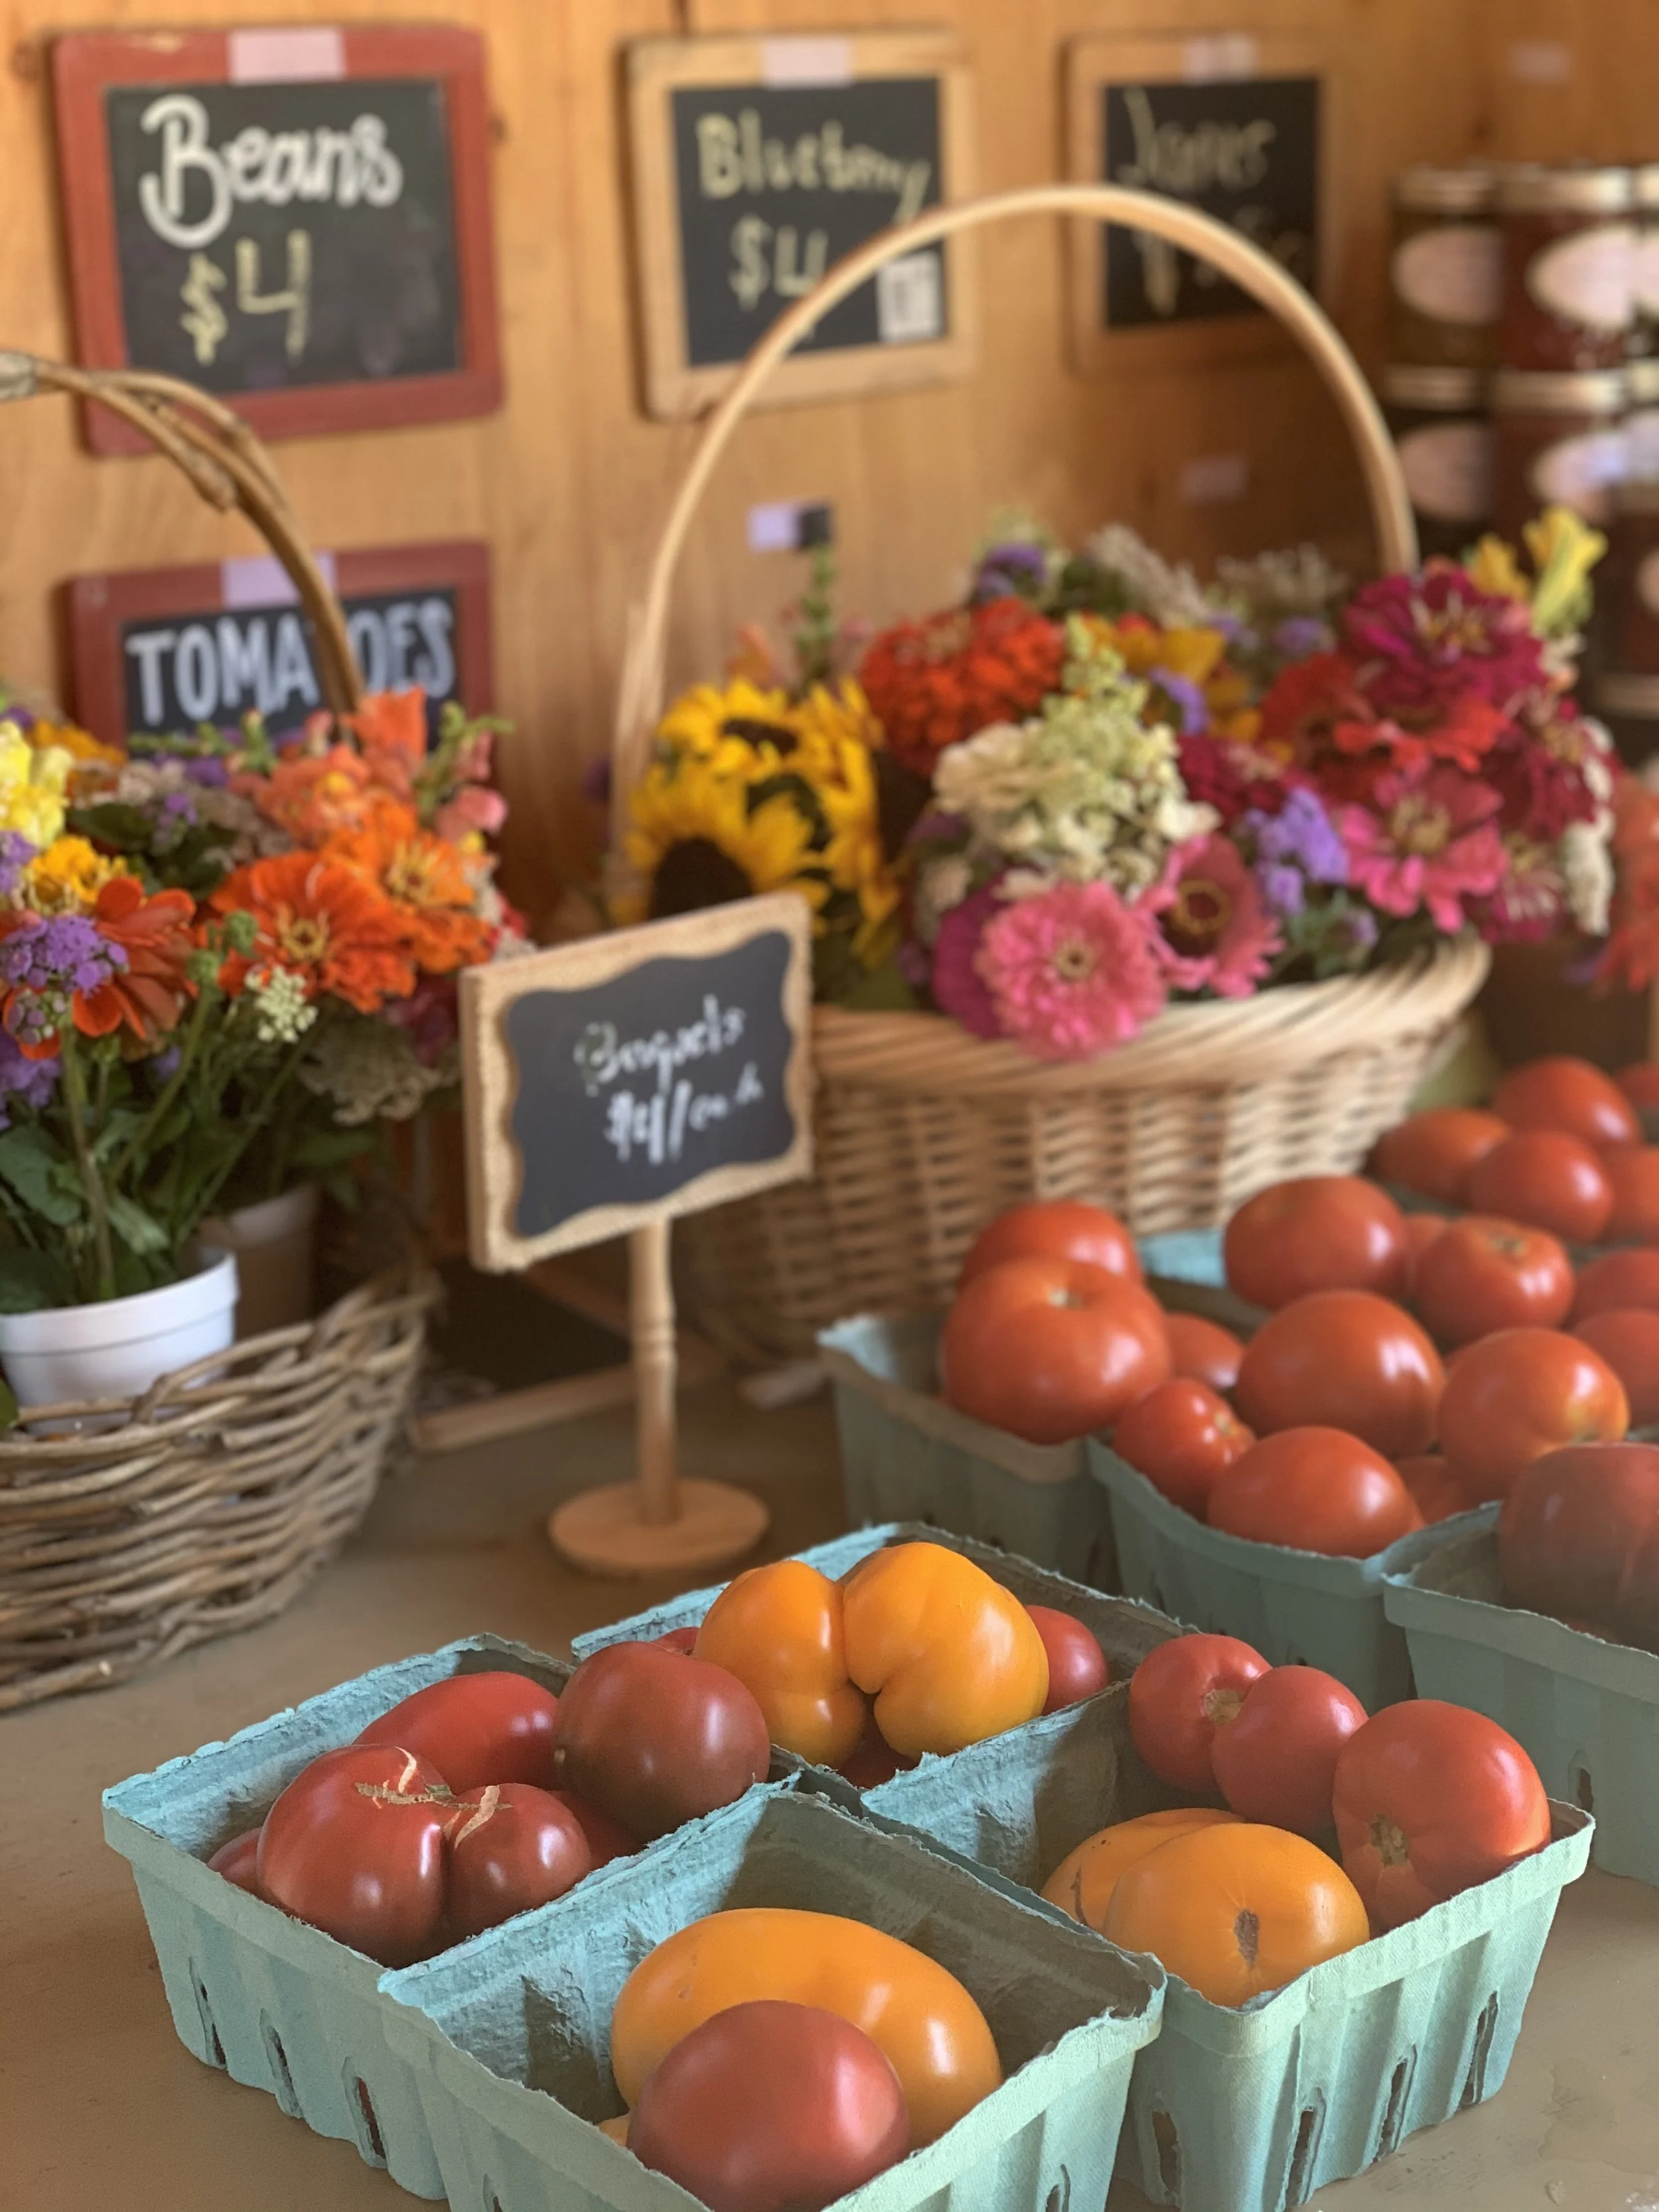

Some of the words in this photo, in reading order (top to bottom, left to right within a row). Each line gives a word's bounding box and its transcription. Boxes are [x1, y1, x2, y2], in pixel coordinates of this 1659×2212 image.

[139, 94, 403, 248] Beans
[180, 228, 312, 366] $4
[729, 212, 828, 312] $4
[125, 597, 456, 726] TOMAOES
